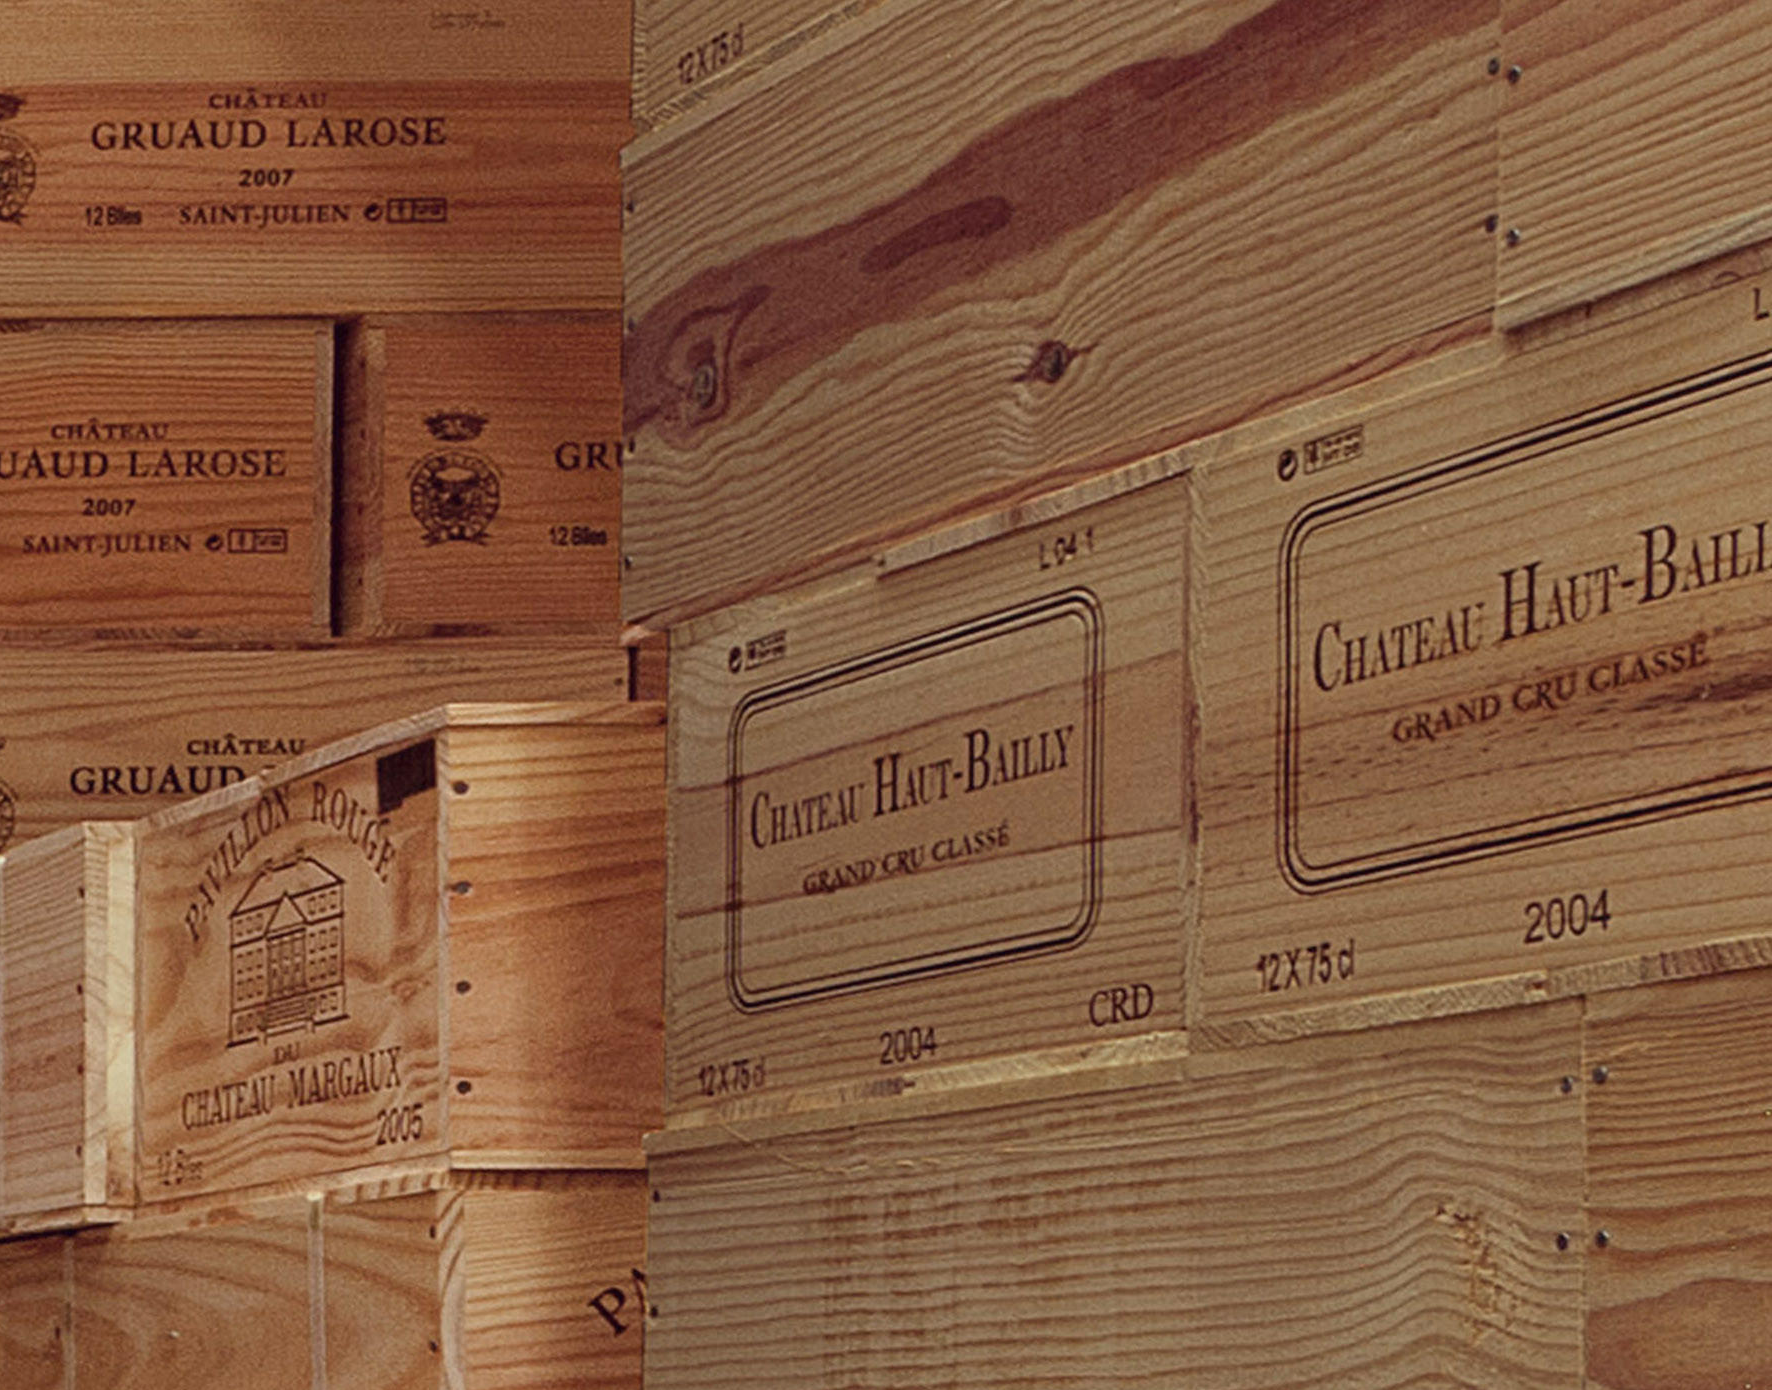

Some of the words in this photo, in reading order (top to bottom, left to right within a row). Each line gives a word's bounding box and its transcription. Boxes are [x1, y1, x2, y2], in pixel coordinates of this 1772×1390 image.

[209, 90, 329, 111] CHÂTEAU
[91, 117, 269, 150] GRUAUD
[286, 116, 448, 148] LAROSE
[239, 168, 294, 188] 2007
[178, 203, 351, 228] SAINT-JULIEN
[50, 420, 171, 442] CHÂTEAU
[127, 448, 286, 480] LAROSE
[82, 499, 137, 518] 2007
[22, 533, 193, 556] SAINT-JULIEN
[1313, 601, 1485, 692] CHATEAU
[1391, 696, 1500, 746] GRAND
[1512, 673, 1577, 713] CRU
[186, 732, 306, 757] CHÂTEAU
[68, 765, 246, 797] GRUAUD
[749, 783, 866, 850] CHATEAU
[871, 724, 1075, 817] HAUT-BAILLY
[186, 785, 291, 943] PAVILLON
[310, 779, 396, 884] ROUGE
[802, 858, 878, 898] GRAND
[880, 846, 926, 877] CRU
[1523, 889, 1611, 945] 2004
[1089, 982, 1155, 1028] CRD
[879, 1027, 938, 1066] 2004
[182, 1071, 276, 1132] CHATEAU
[288, 1046, 403, 1104] MARGAUX
[375, 1111, 424, 1147] 2005
